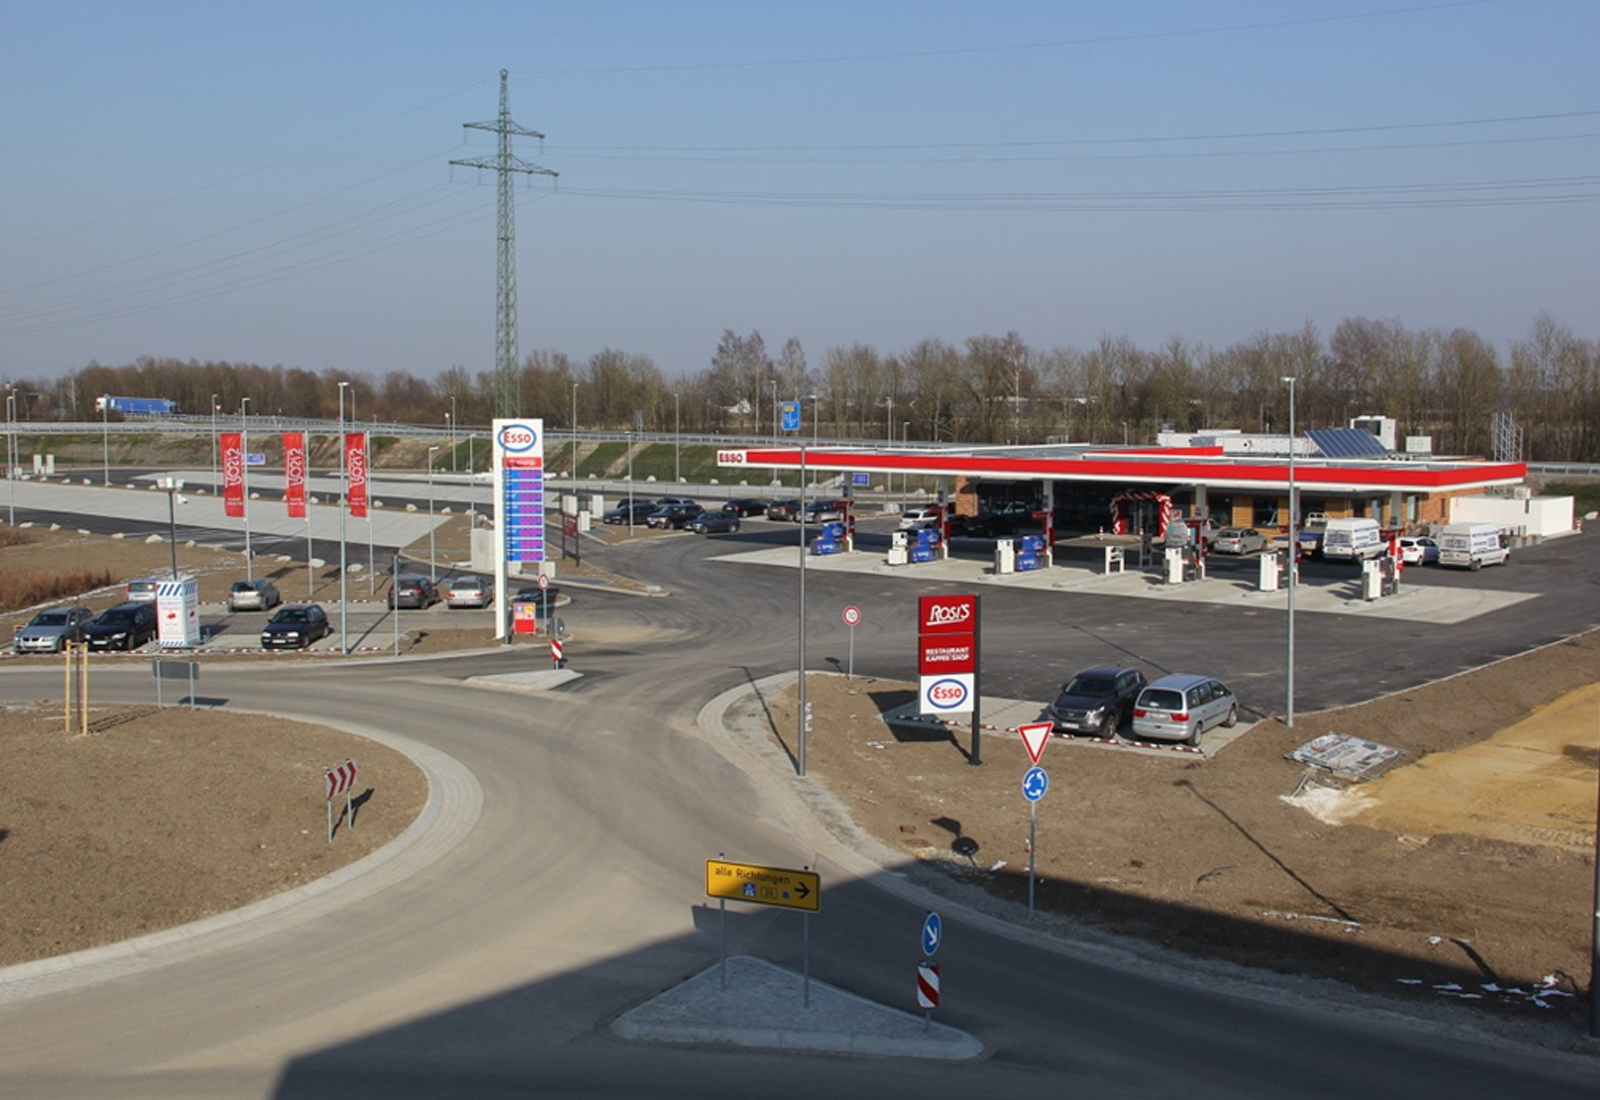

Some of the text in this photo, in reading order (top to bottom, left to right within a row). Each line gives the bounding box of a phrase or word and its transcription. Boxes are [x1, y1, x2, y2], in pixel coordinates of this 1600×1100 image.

[503, 431, 532, 443] Esso
[719, 453, 743, 463] ESSO
[925, 647, 970, 655] RESTAURANT
[933, 686, 963, 699] Esso
[715, 867, 790, 885] alle Richtungen
